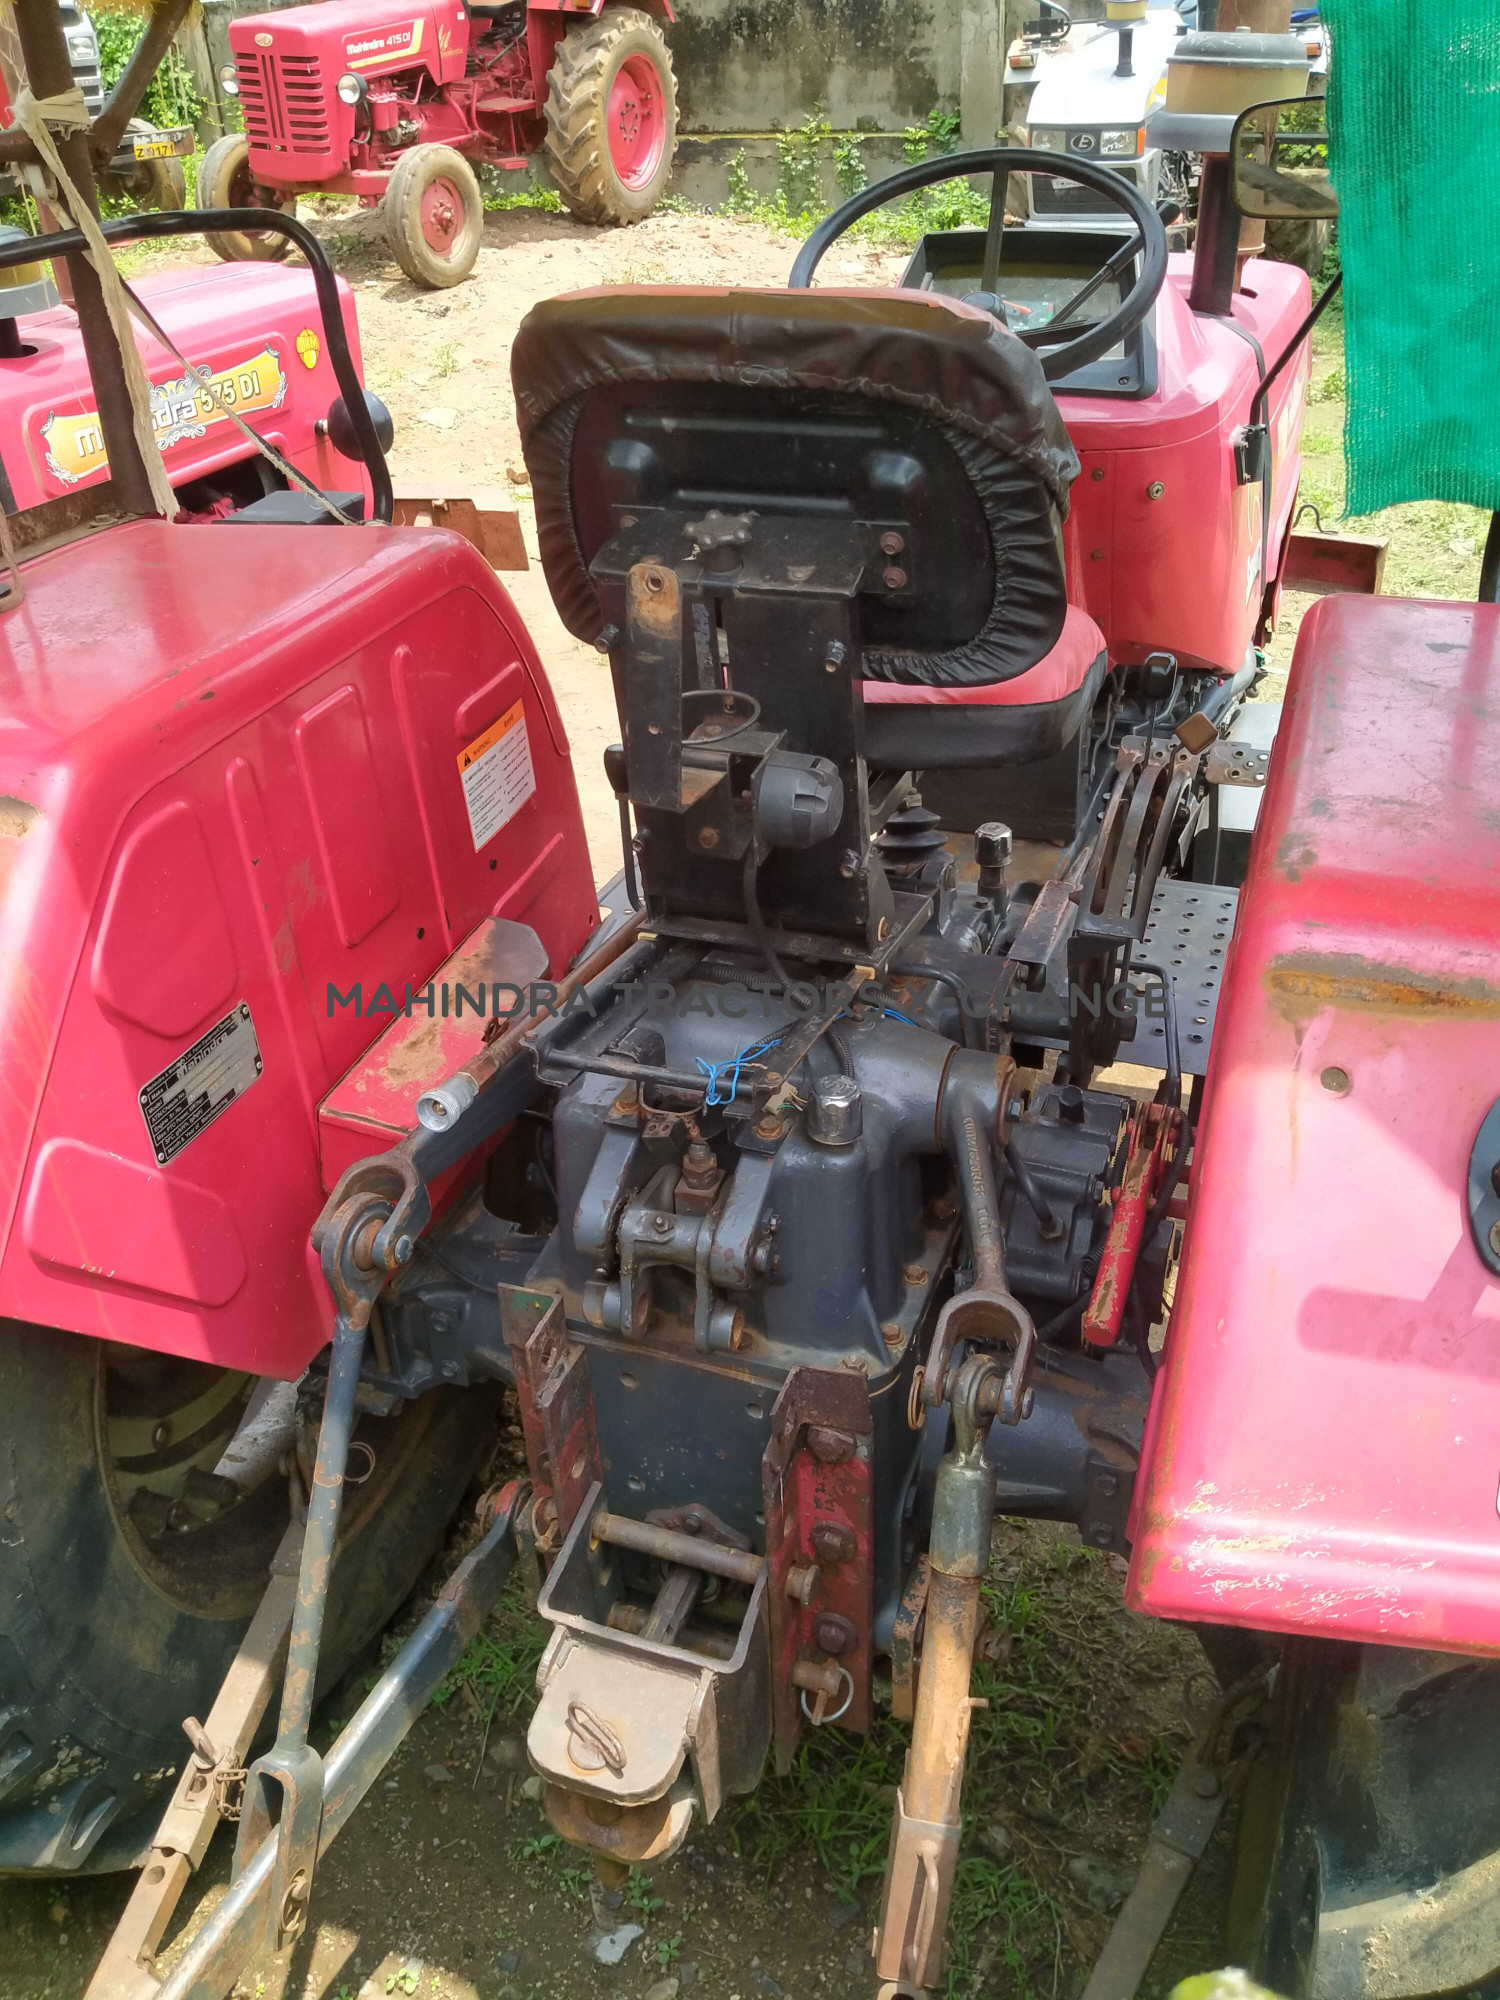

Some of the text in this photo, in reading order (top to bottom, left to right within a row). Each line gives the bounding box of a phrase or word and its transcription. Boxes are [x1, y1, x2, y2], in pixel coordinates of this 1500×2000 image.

[346, 40, 384, 55] Mahindra
[402, 32, 411, 43] DI
[200, 378, 237, 413] 575
[238, 370, 261, 400] DI
[148, 1097, 162, 1114] Model
